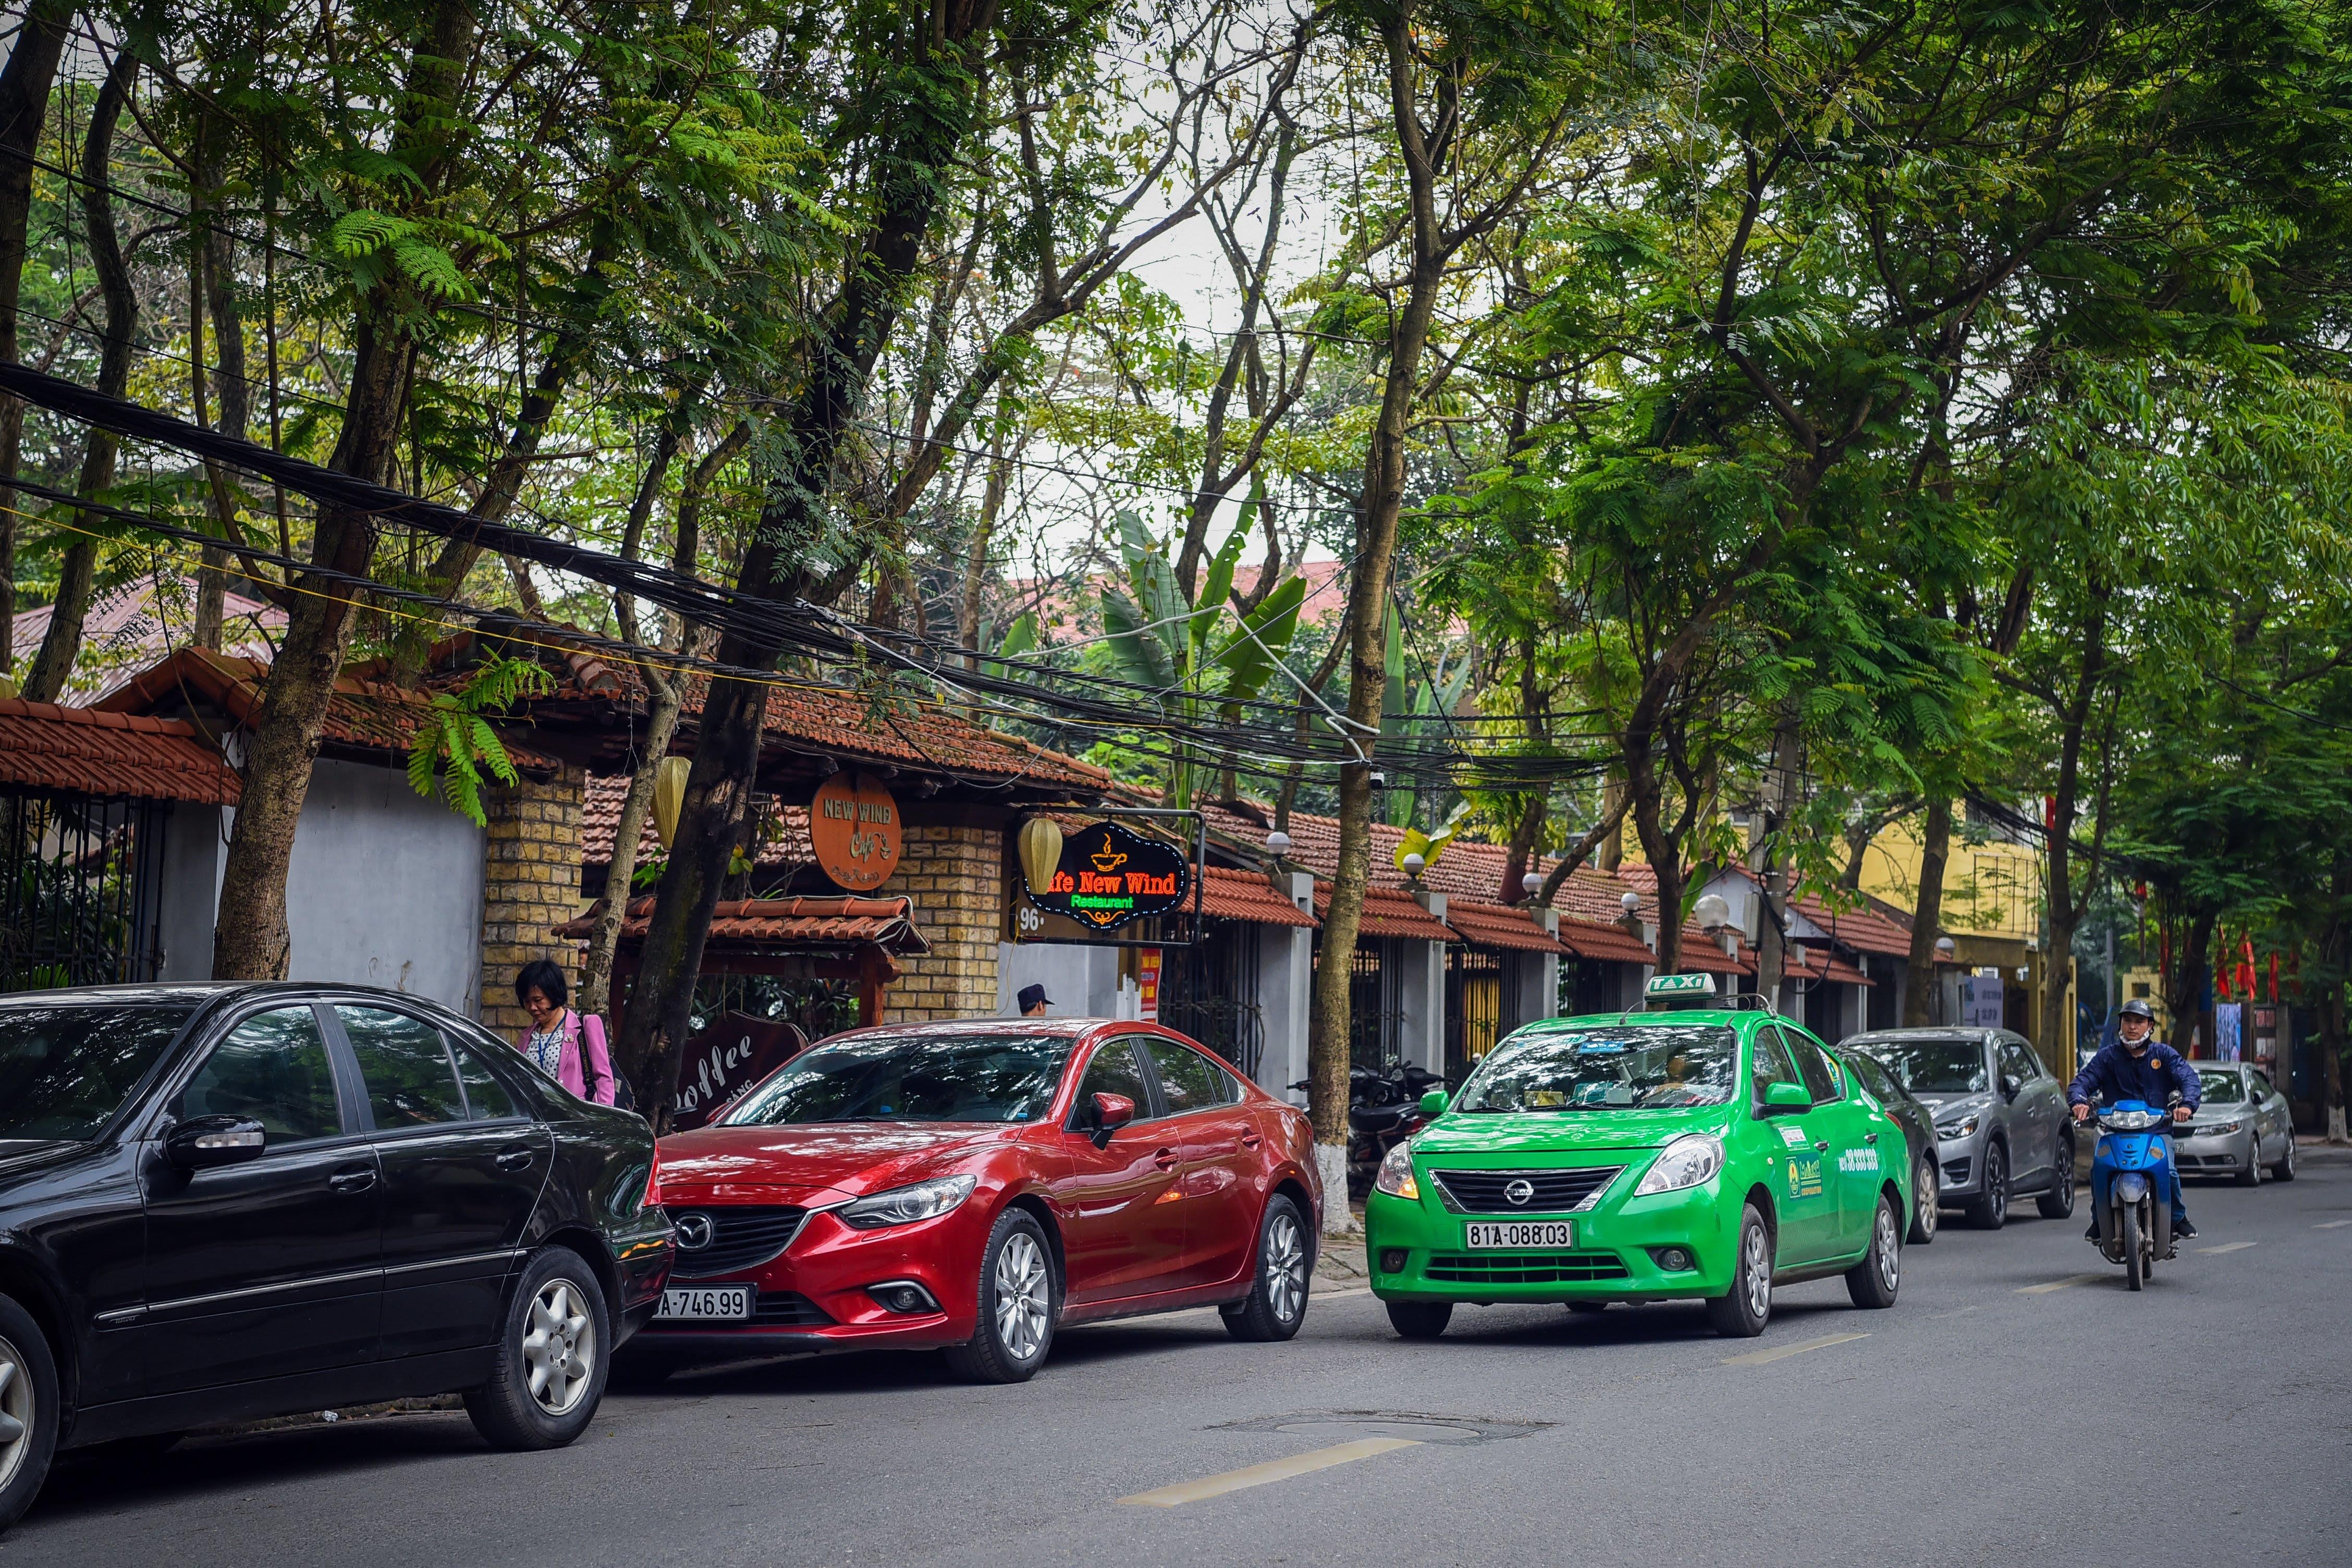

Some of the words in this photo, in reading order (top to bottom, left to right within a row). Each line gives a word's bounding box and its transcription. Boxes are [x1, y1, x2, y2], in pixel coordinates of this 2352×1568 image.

[823, 799, 855, 820] NEW
[858, 803, 891, 824] WIND
[1079, 872, 1122, 893] New
[1125, 872, 1175, 895] Wind
[1071, 895, 1134, 909] Restaurant
[1020, 907, 1038, 930] 96
[1471, 1225, 1567, 1245] 81A-088.03
[655, 1292, 743, 1316] A-746.99
